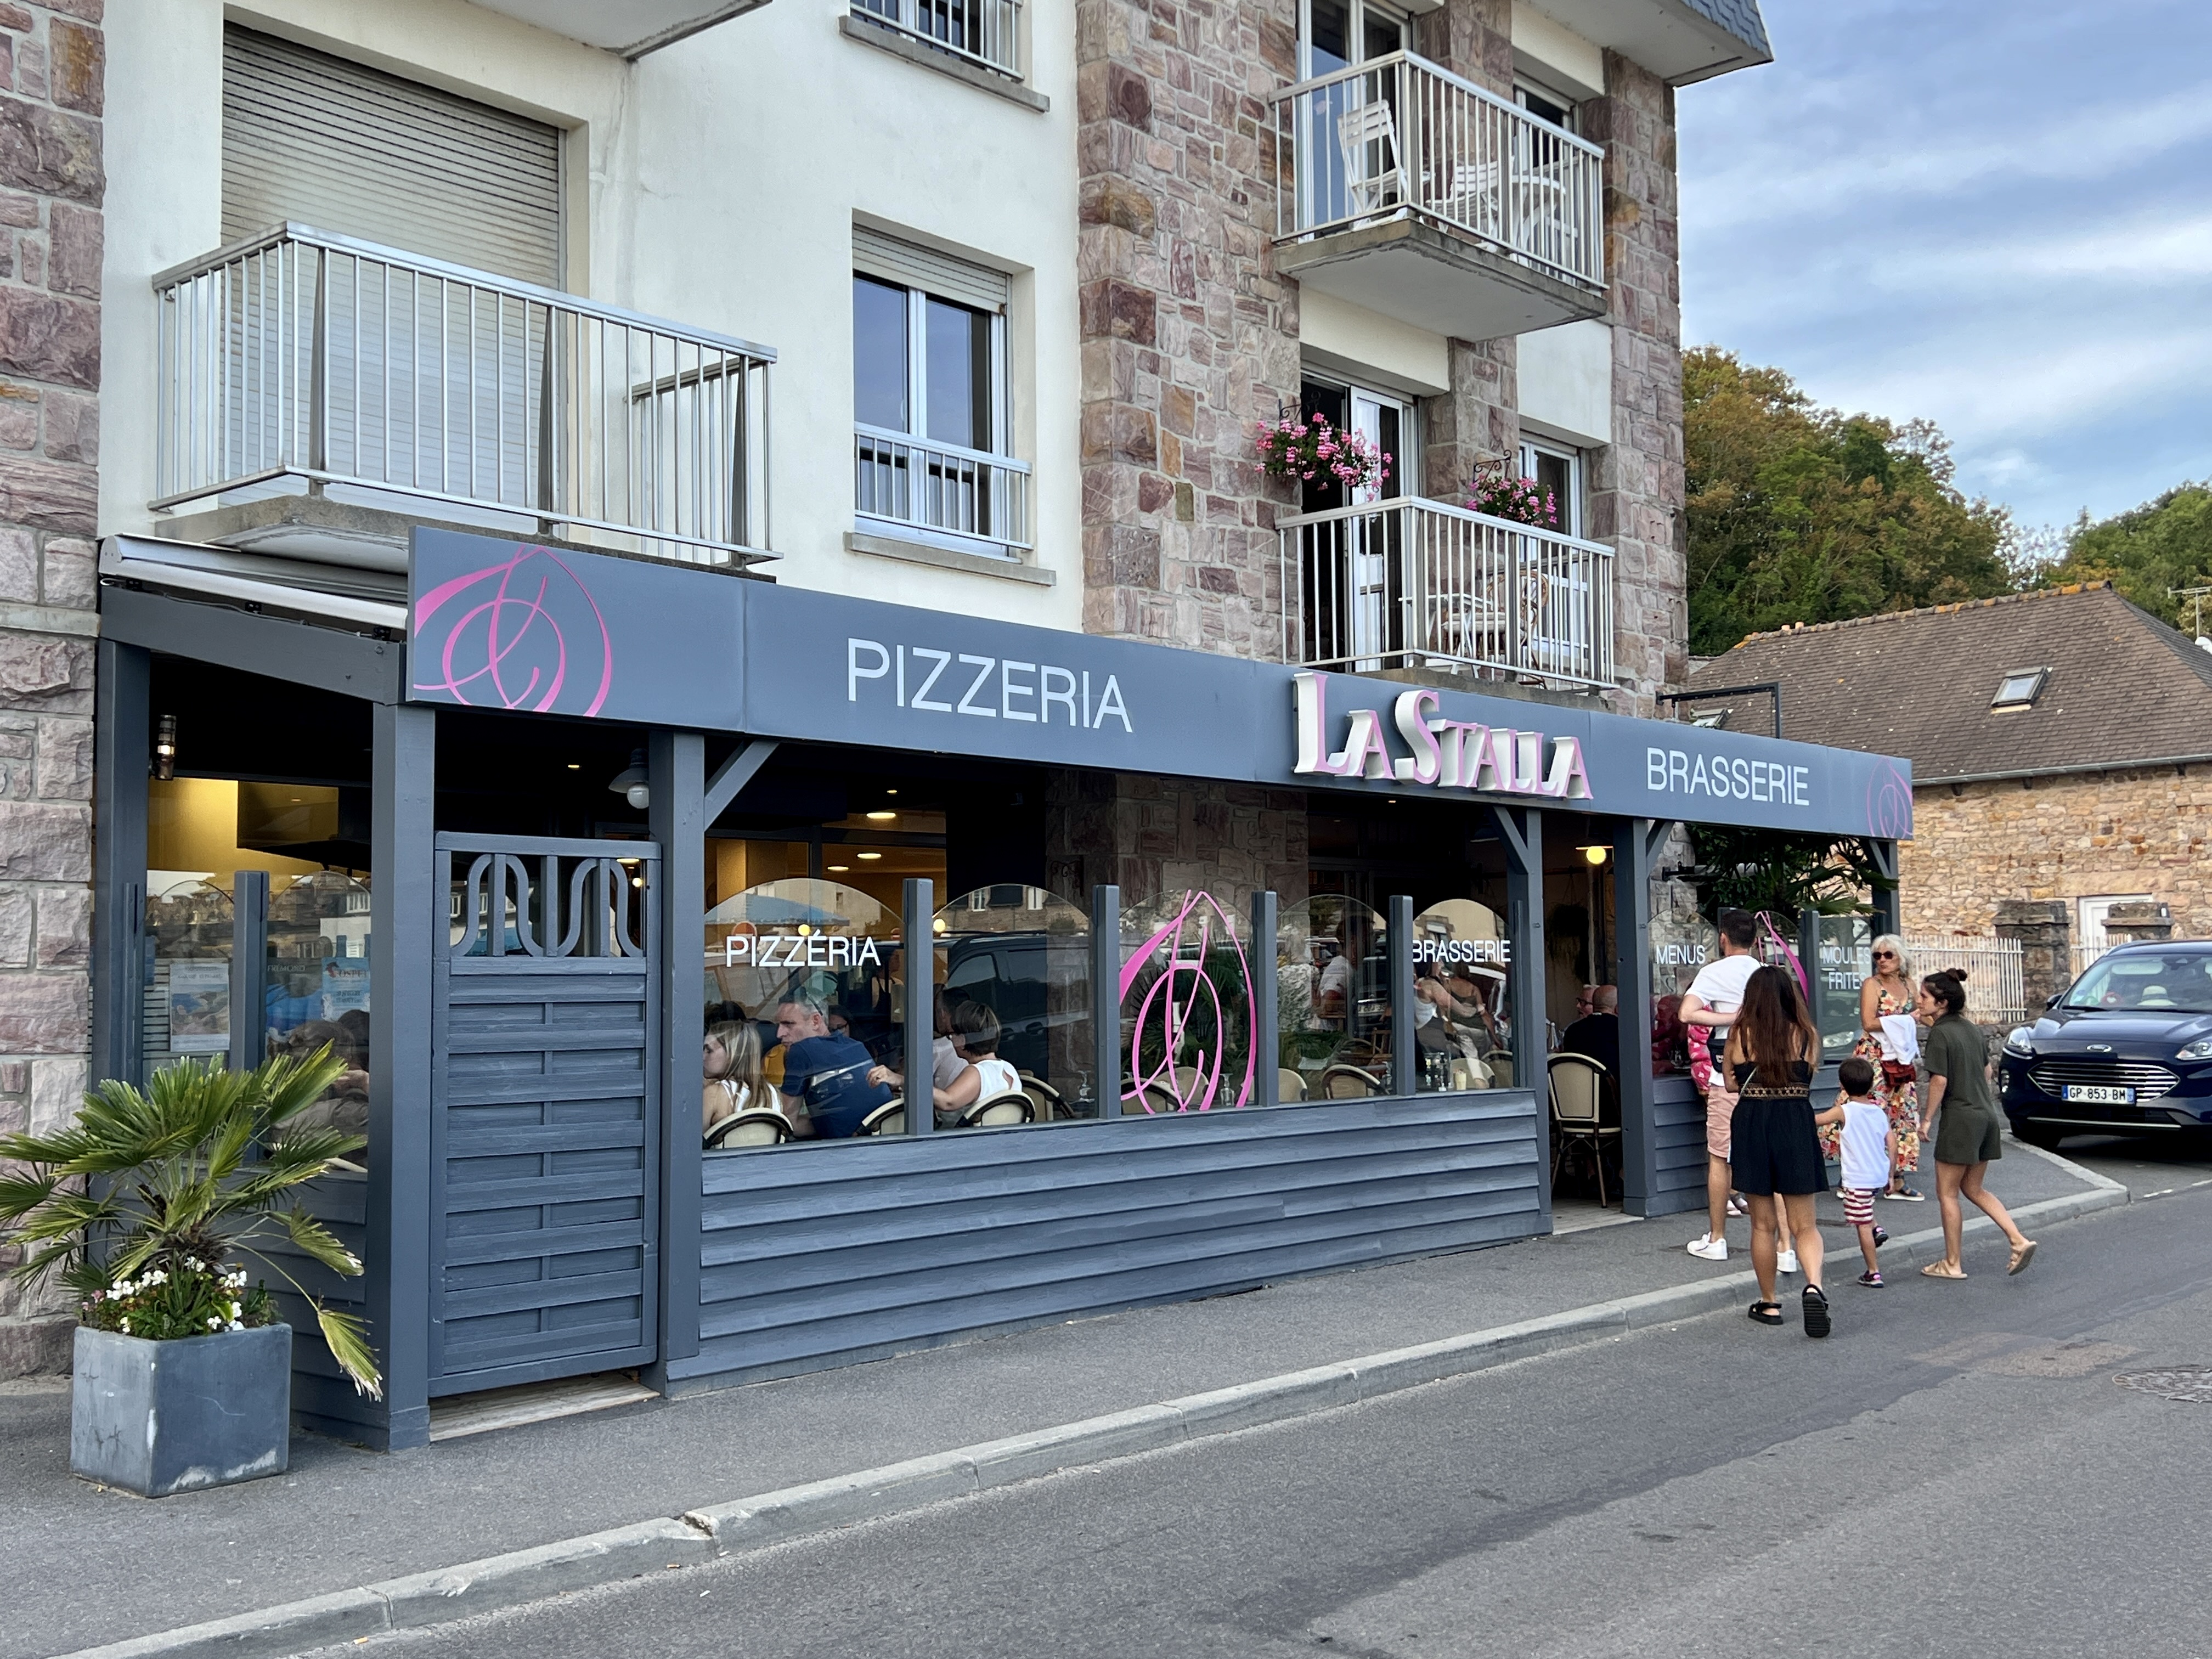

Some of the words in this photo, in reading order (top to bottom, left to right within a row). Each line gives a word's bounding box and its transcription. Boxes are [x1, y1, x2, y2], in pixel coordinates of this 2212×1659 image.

[848, 637, 1133, 733] PIZZERIA
[1647, 747, 1810, 806] BRASSERIE
[726, 929, 882, 968] PIZZÉRIA
[1412, 939, 1511, 963] BRASSERIE
[1656, 944, 1706, 964] MENUS
[1822, 946, 1871, 964] MOULES
